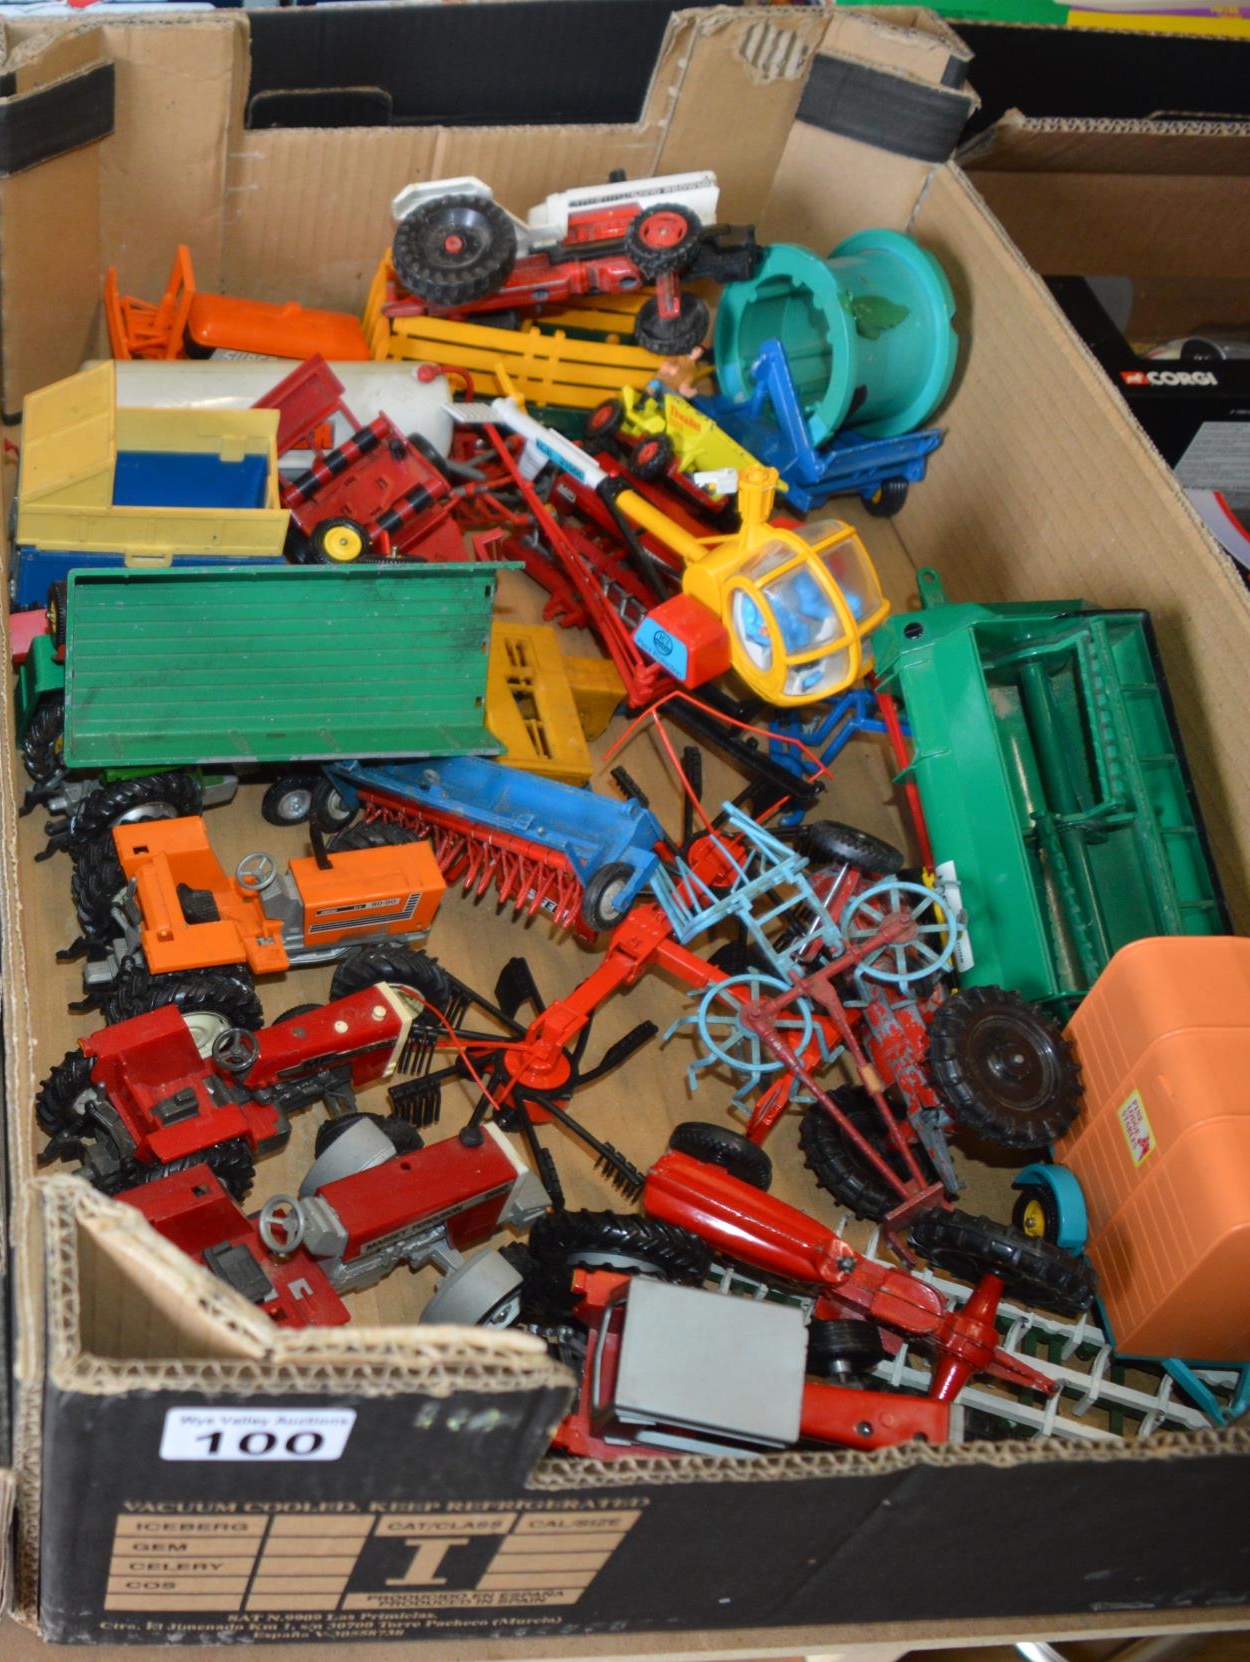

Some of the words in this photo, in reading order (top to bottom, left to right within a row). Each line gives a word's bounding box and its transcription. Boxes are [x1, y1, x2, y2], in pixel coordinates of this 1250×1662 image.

[1147, 371, 1218, 386] CORGI
[221, 1415, 269, 1426] Valley
[276, 1415, 348, 1425] Auctions
[196, 1431, 324, 1455] 100
[123, 1502, 238, 1513] VACUUM
[368, 1501, 441, 1512] KEEP
[449, 1496, 650, 1512] REFRIGERATED
[135, 1522, 249, 1532] ICEBERG
[387, 1520, 504, 1532] CAT/CLASS
[528, 1517, 623, 1529] CAL/SIZE
[132, 1543, 189, 1552] GEM
[129, 1563, 225, 1571] CELERY
[385, 1537, 470, 1586] I
[125, 1582, 177, 1590] COS
[227, 1614, 264, 1623] SAT
